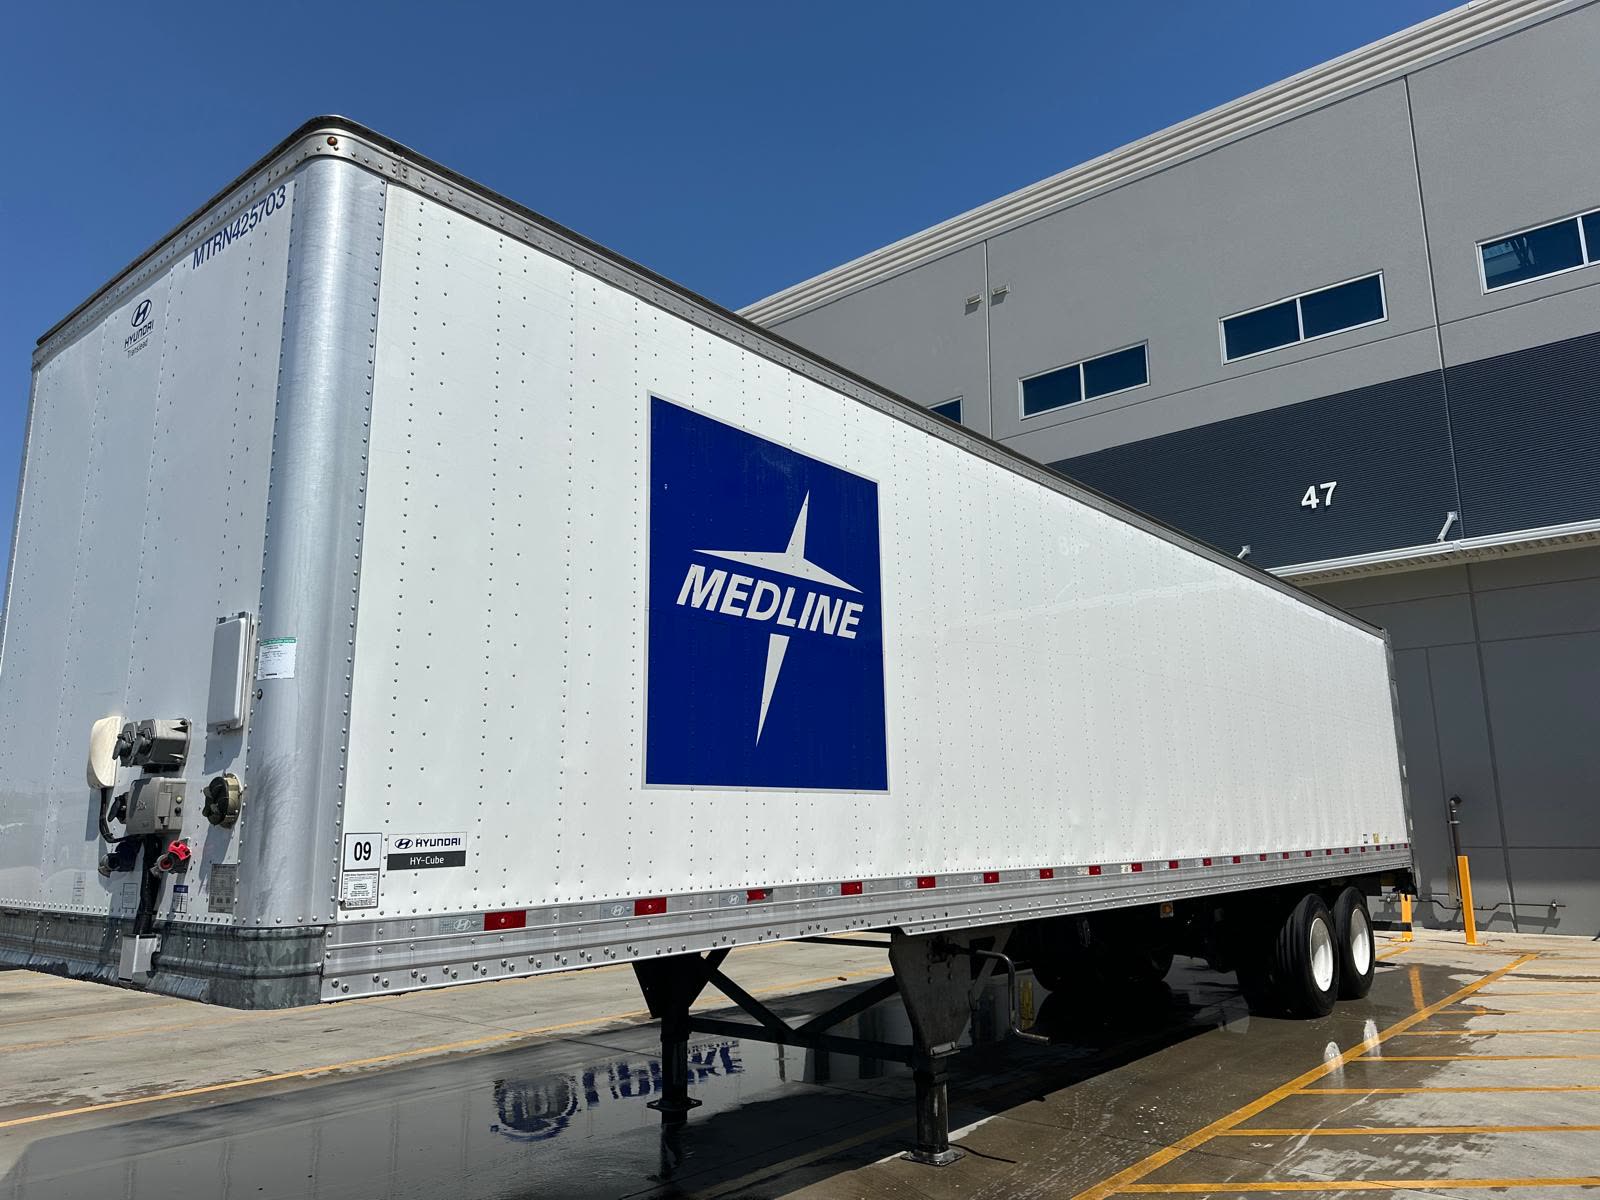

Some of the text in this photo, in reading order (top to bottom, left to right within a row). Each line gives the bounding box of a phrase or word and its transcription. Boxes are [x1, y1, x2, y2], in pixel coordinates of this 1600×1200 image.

[192, 184, 287, 270] MTRN425703
[124, 319, 155, 349] HYUNDAI
[1301, 481, 1337, 509] 47
[676, 563, 864, 640] MEDLINE
[353, 841, 372, 861] 09
[415, 837, 461, 848] HYUNDAI
[409, 855, 445, 866] HY-Cube
